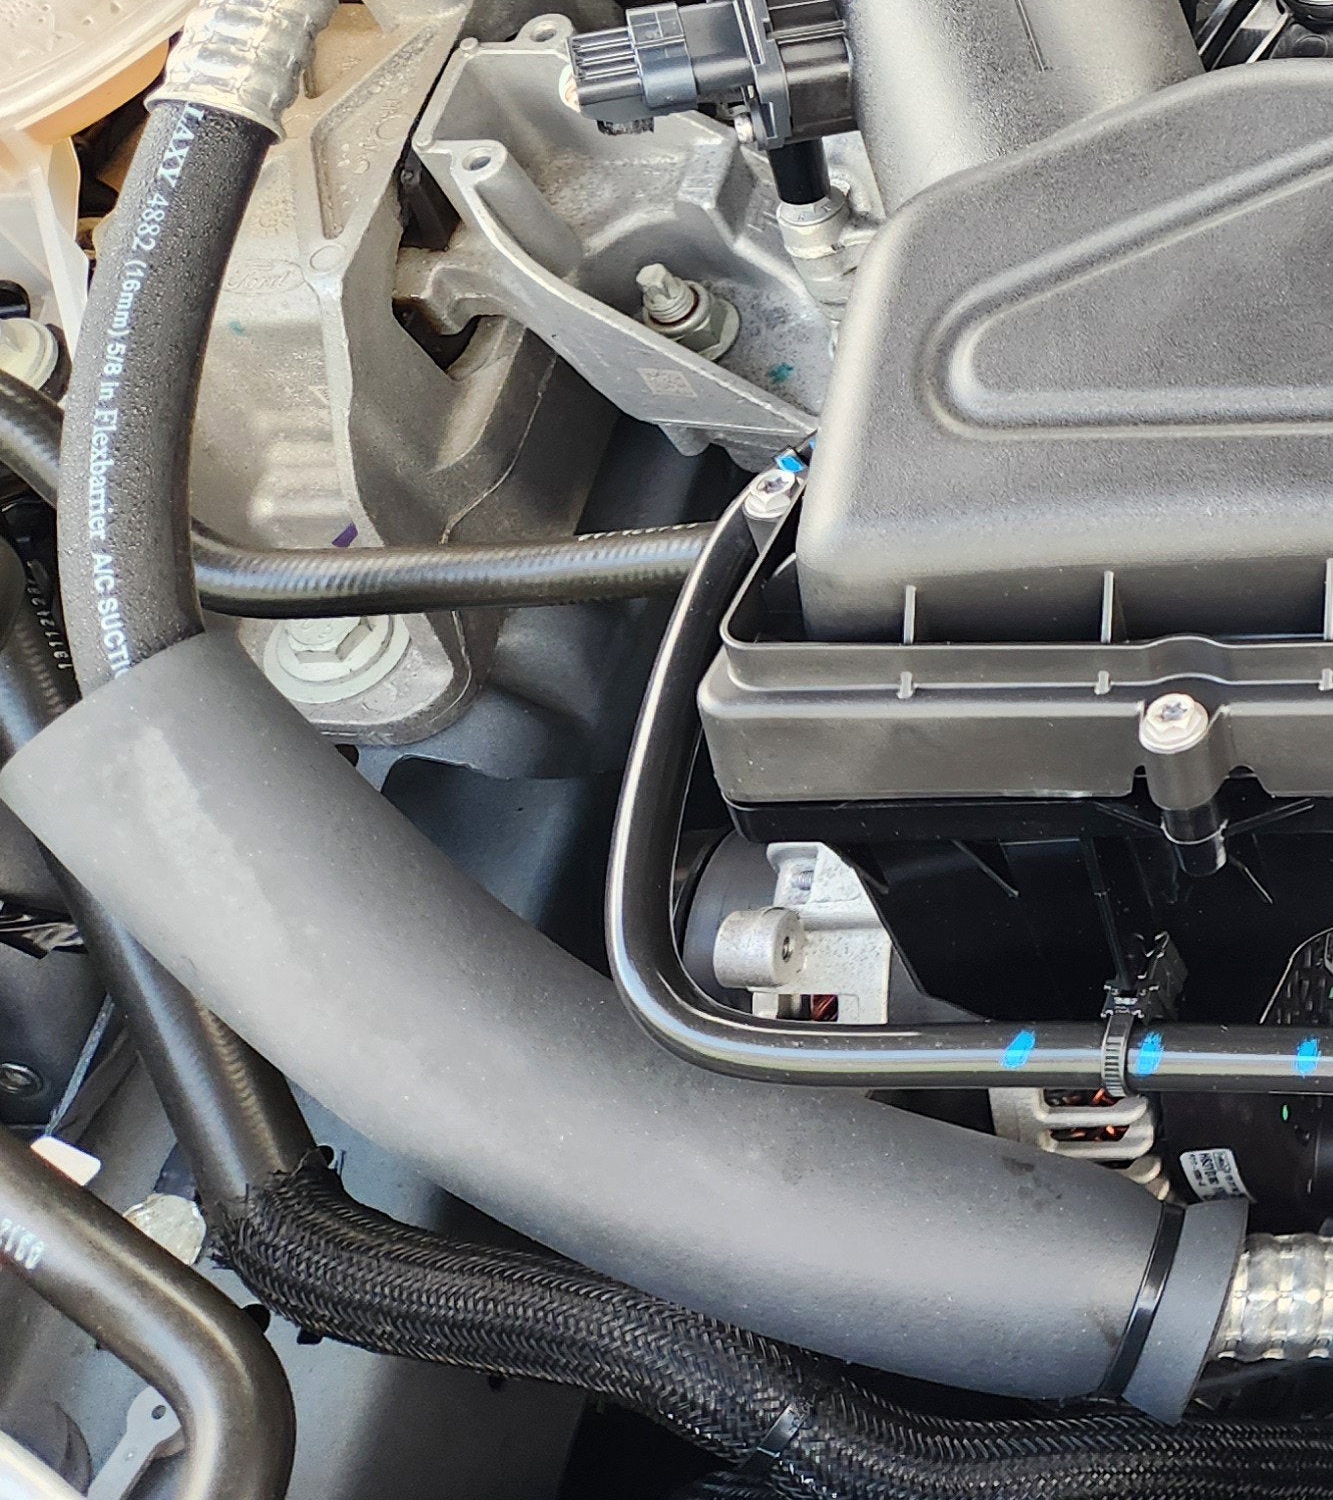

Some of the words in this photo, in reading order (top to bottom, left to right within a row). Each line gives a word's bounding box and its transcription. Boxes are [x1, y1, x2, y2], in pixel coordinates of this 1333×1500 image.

[131, 191, 169, 251] 4882
[106, 259, 147, 337] (16mm)
[102, 341, 127, 376] 5/8
[98, 380, 120, 401] in
[87, 407, 119, 542] Flexbarrier
[91, 551, 115, 595] A/C
